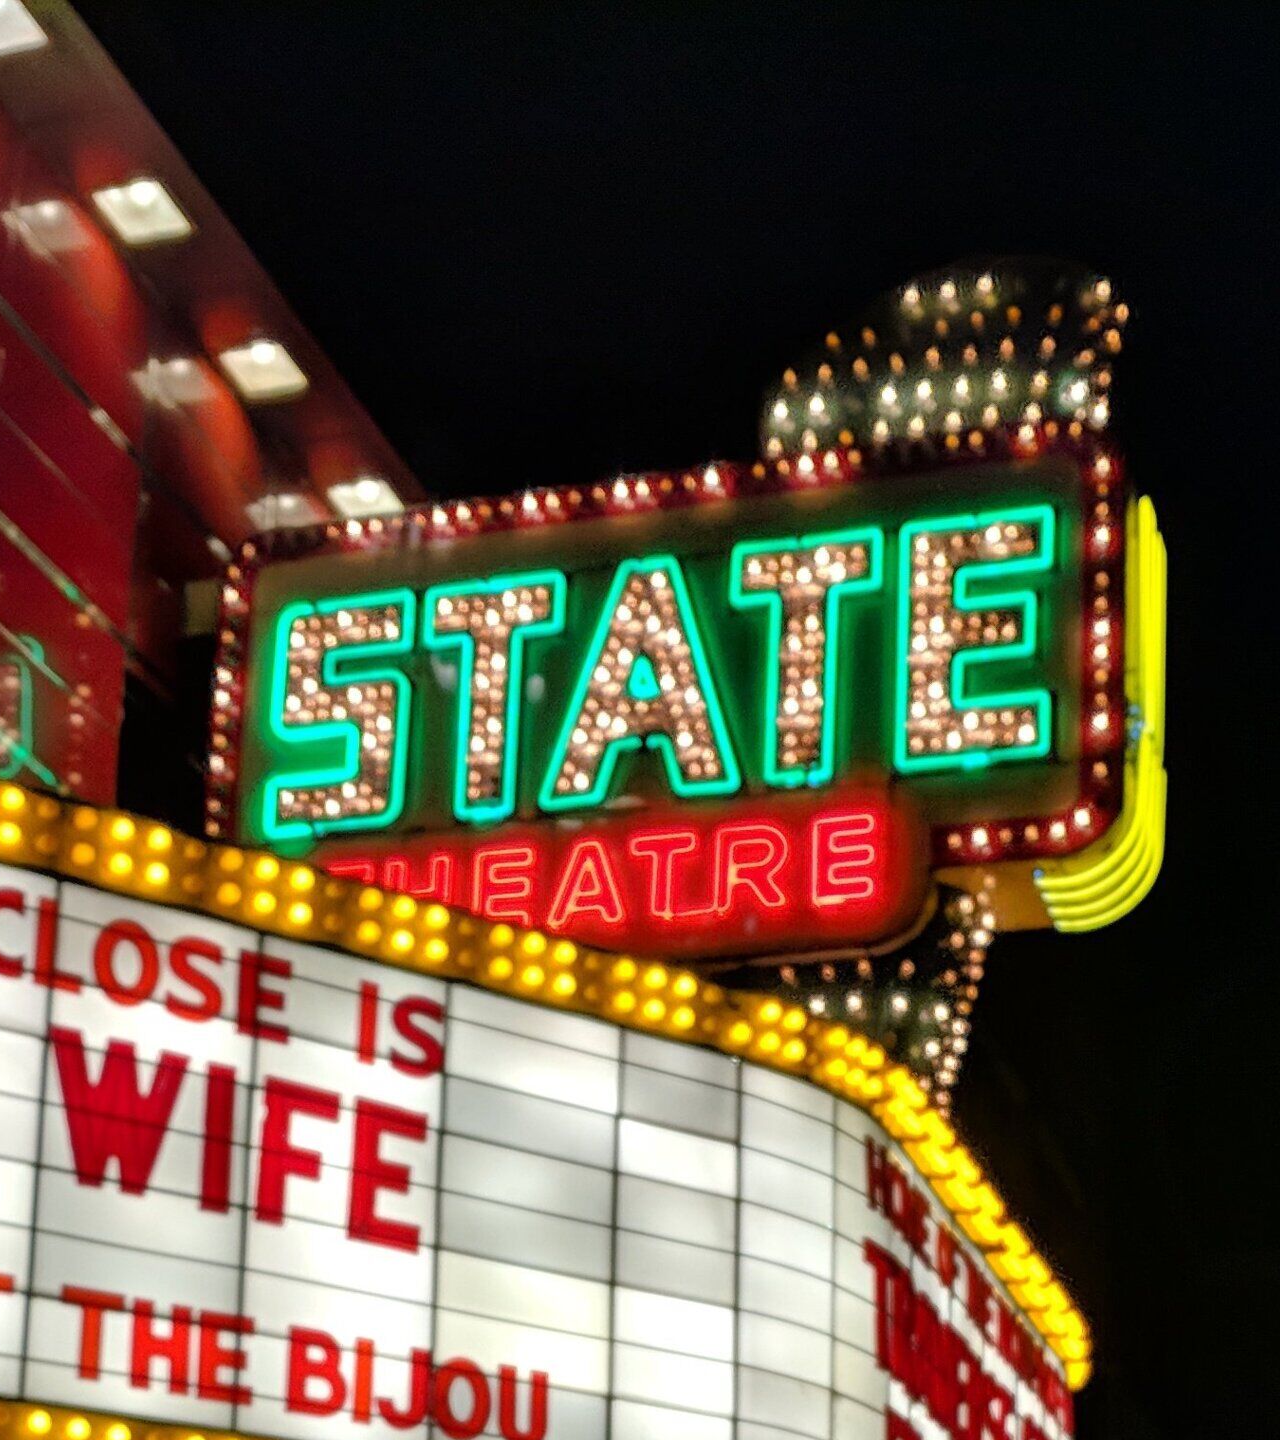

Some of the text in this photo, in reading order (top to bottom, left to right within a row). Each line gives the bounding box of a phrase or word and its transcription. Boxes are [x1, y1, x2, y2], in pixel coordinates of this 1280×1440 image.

[262, 503, 1057, 843] STATE
[357, 981, 445, 1078] IS
[49, 1026, 428, 1253] WIFE
[63, 1286, 254, 1405] THE
